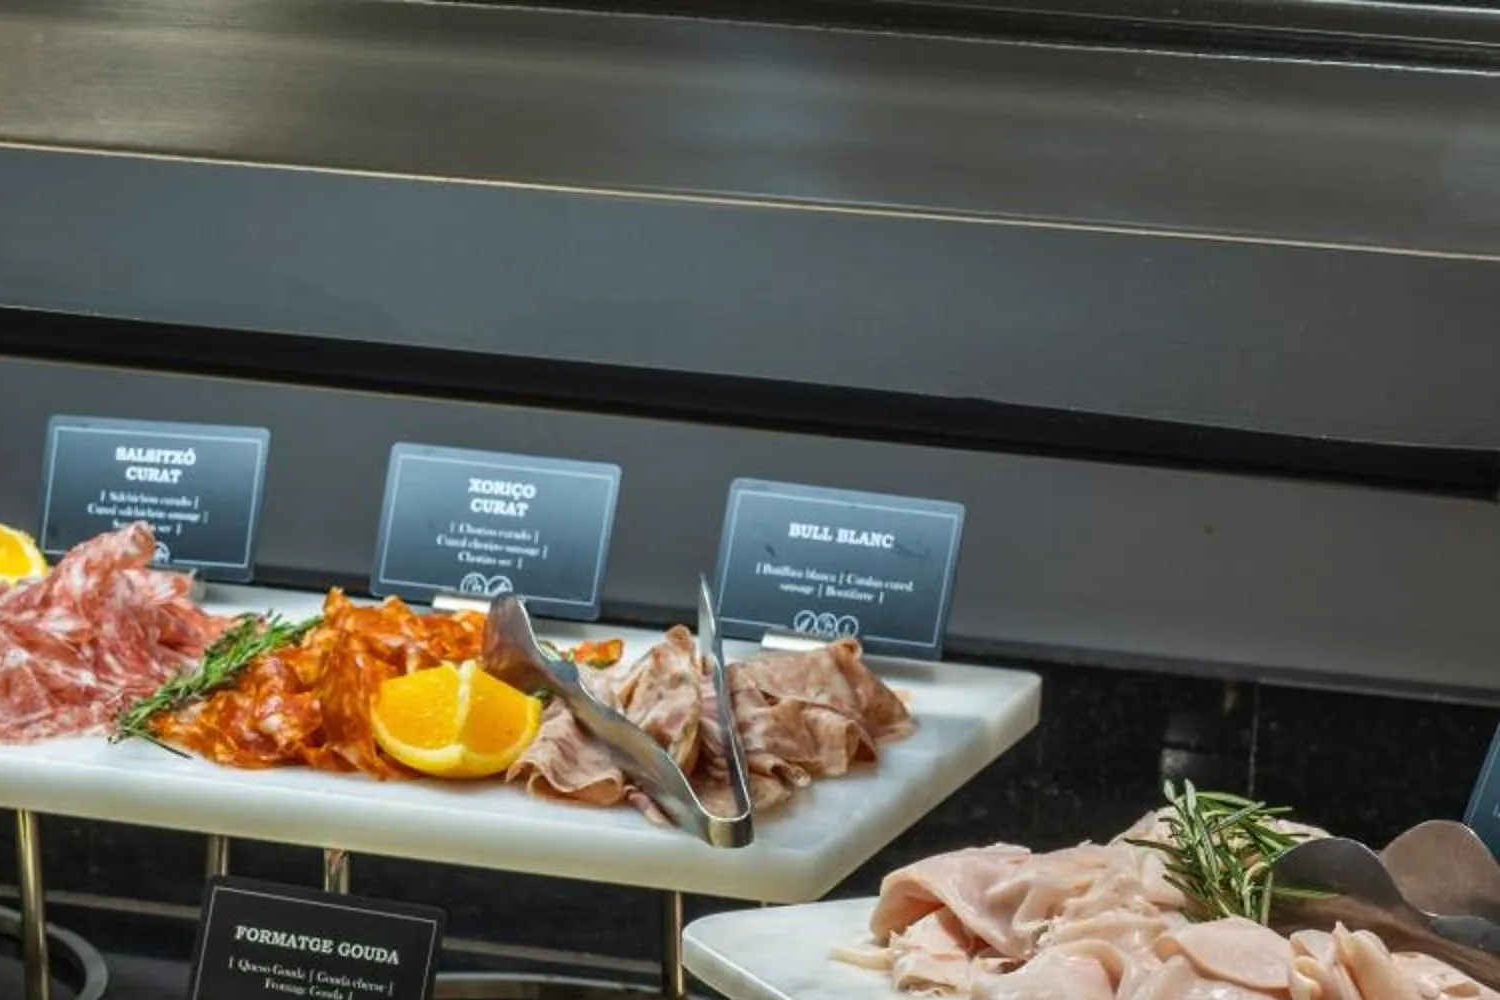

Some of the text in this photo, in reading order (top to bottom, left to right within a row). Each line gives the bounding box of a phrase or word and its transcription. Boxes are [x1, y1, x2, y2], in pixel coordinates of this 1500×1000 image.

[125, 467, 183, 483] CURAT
[468, 478, 537, 499] XORIÇO
[470, 499, 529, 517] CURAT
[788, 523, 896, 548] BULL BLANC
[234, 925, 400, 965] FORMATGE GOUDA
